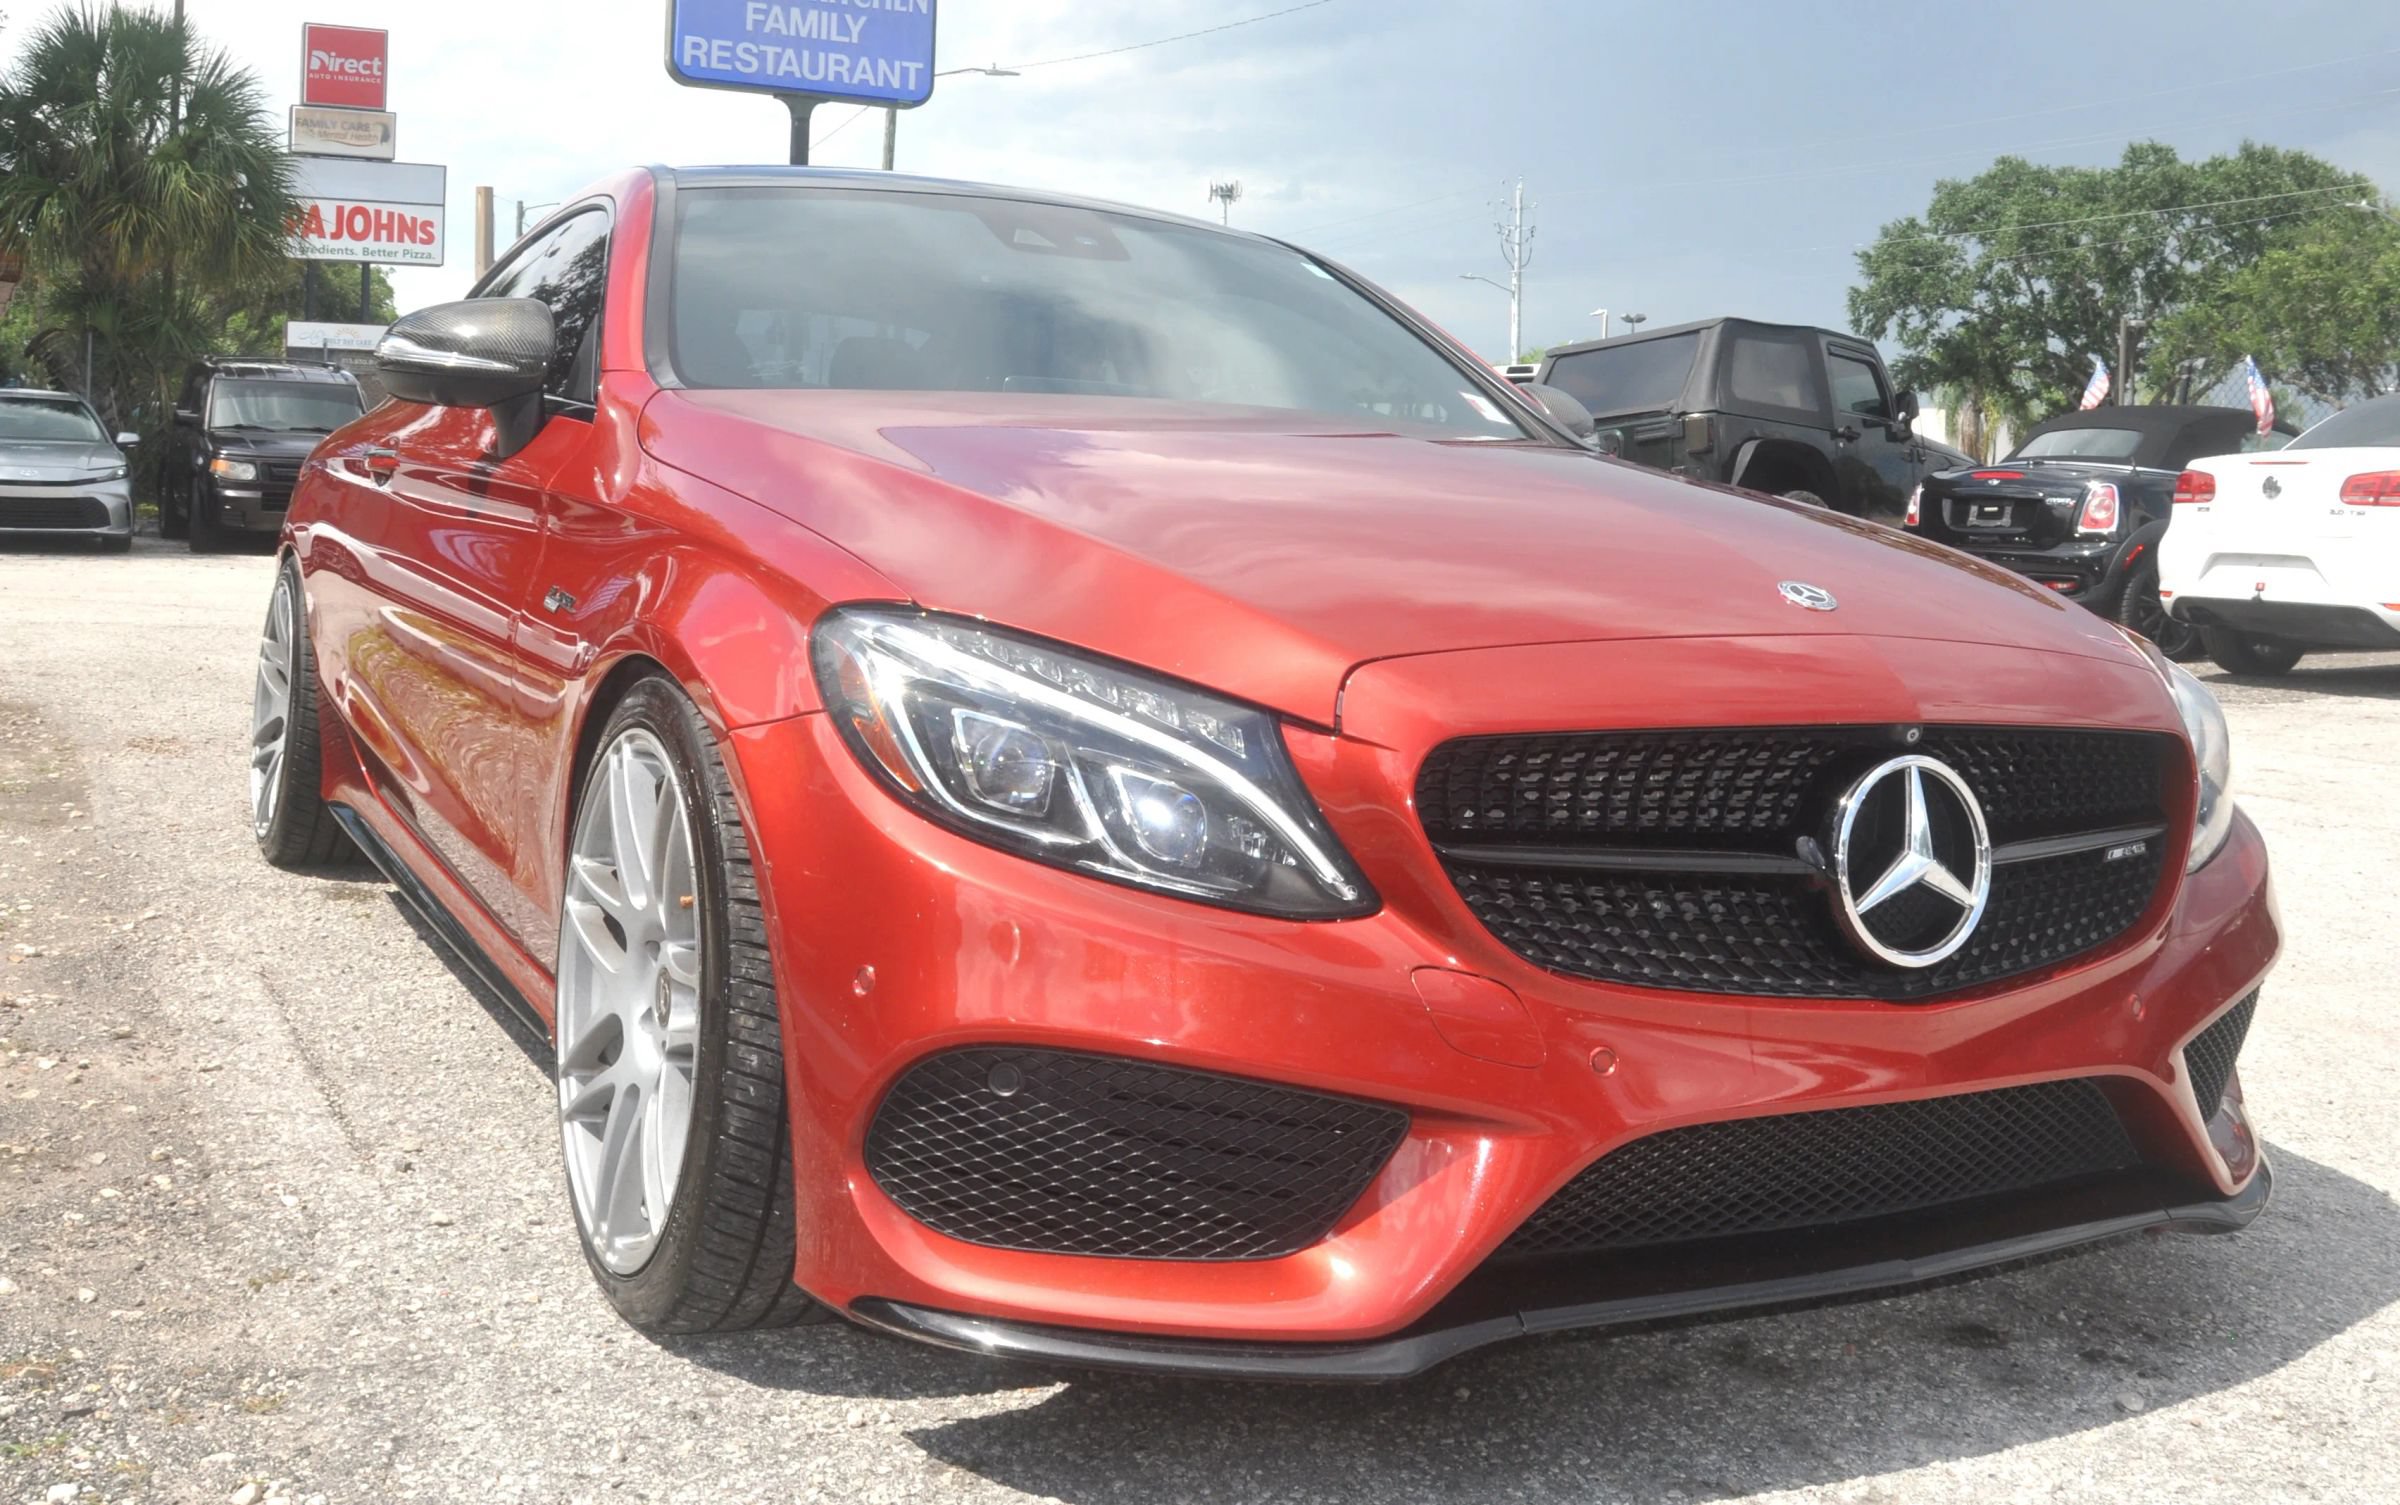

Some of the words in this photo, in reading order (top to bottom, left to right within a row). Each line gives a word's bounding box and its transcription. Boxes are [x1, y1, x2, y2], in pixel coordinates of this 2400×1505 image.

[745, 2, 867, 43] FAMILY
[310, 49, 382, 76] Direct
[683, 35, 923, 90] RESTAURANT
[334, 75, 381, 84] INSURANCE
[295, 117, 337, 130] FAMILY
[340, 121, 371, 133] CARE
[362, 246, 399, 259] Better
[402, 248, 436, 260] Pizza.
